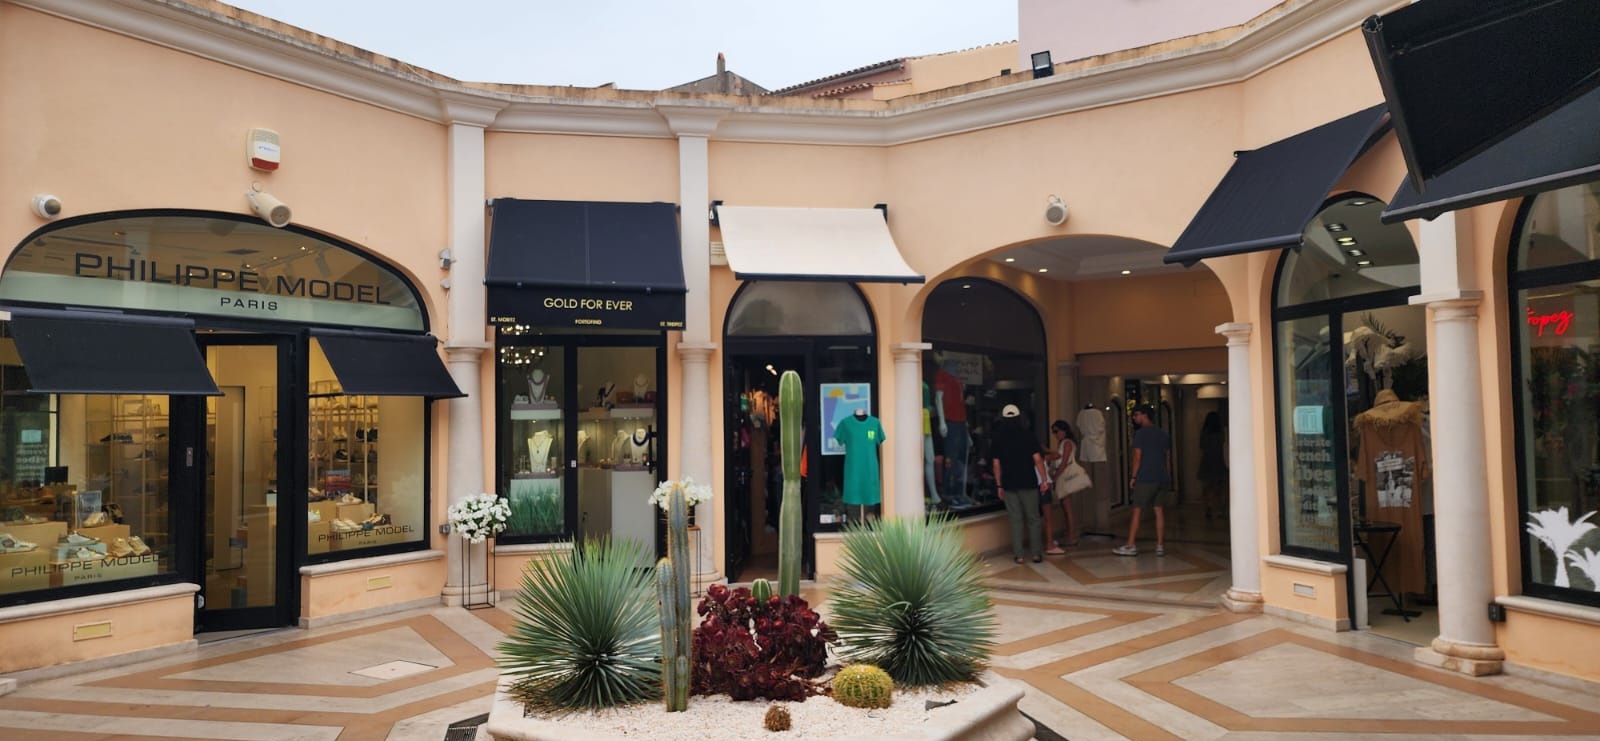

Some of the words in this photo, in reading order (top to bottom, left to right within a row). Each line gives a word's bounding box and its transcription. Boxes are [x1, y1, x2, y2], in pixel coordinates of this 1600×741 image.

[75, 252, 259, 293] PHILIPPE
[277, 275, 391, 305] MODEL
[220, 297, 278, 311] PARIS
[544, 298, 578, 309] GOLD
[580, 299, 603, 310] FOR
[605, 300, 633, 311] EVER
[318, 529, 371, 543] PHILIPPE
[375, 525, 415, 536] MODEL
[11, 560, 93, 578] PHILIPPE
[100, 554, 160, 569] MODEL
